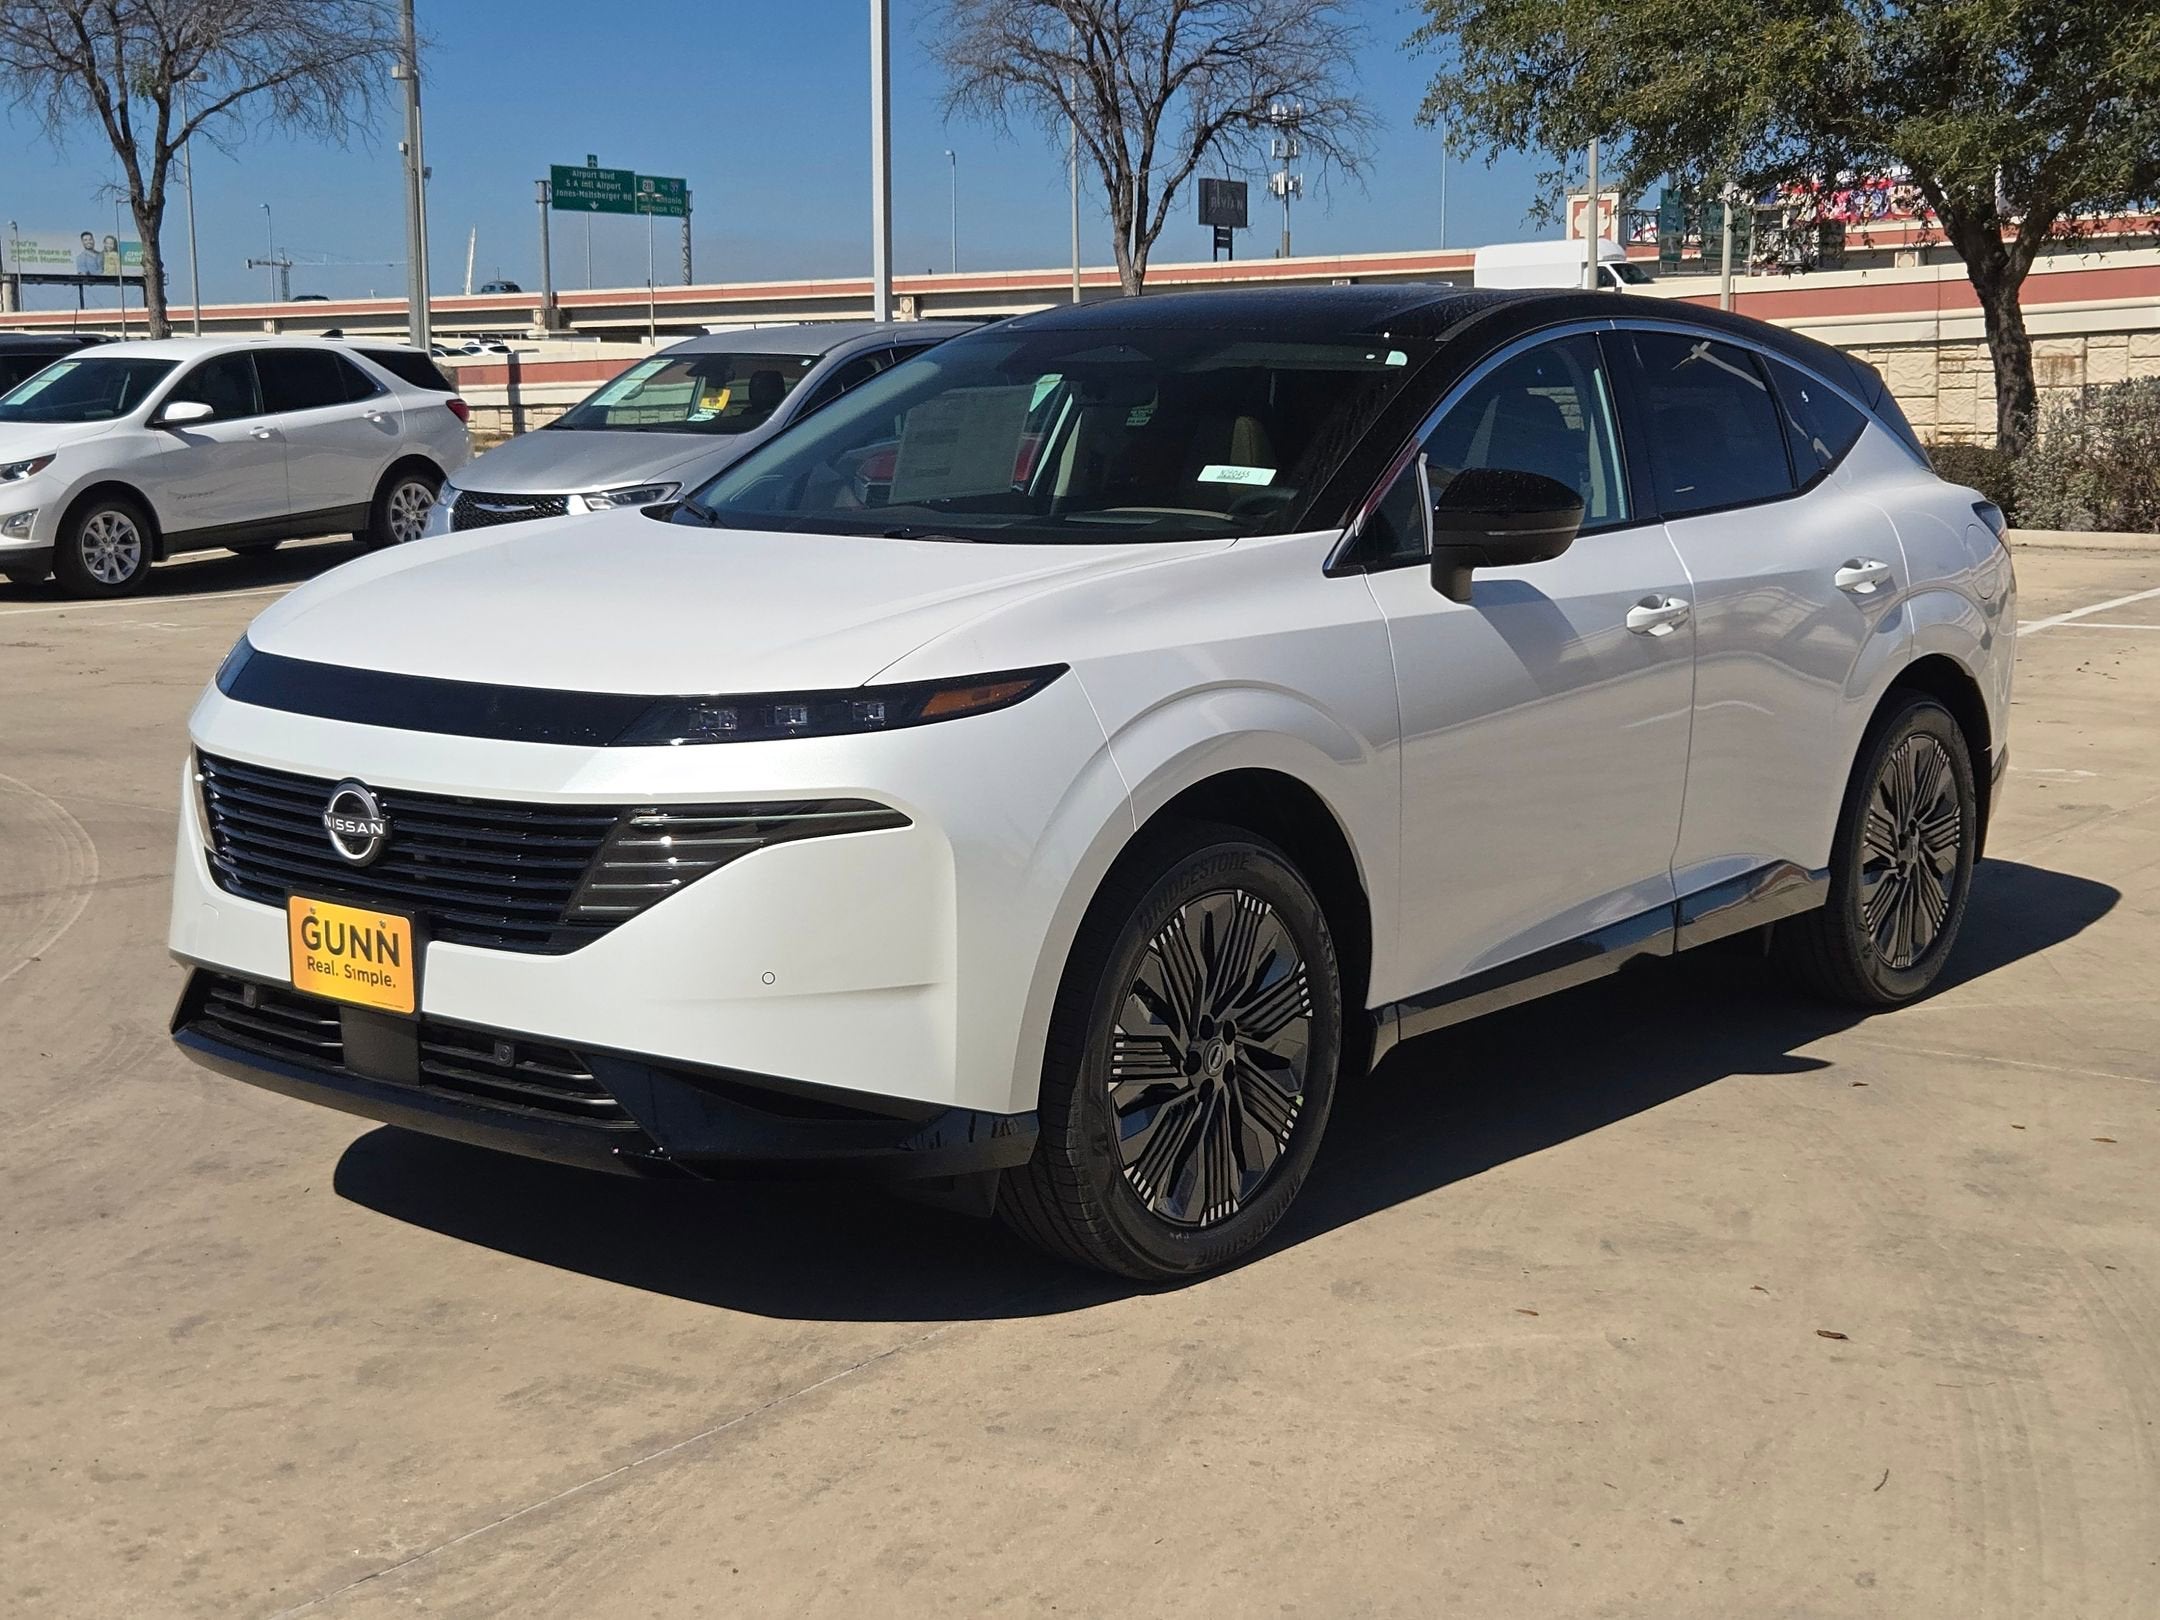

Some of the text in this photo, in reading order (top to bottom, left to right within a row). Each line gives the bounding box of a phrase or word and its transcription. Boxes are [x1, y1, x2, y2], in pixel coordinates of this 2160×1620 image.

[572, 170, 615, 180] Airport Blvd
[596, 181, 622, 190] Airport
[324, 813, 384, 835] NISSAN
[301, 915, 400, 968] GUNN
[307, 955, 339, 977] Real.
